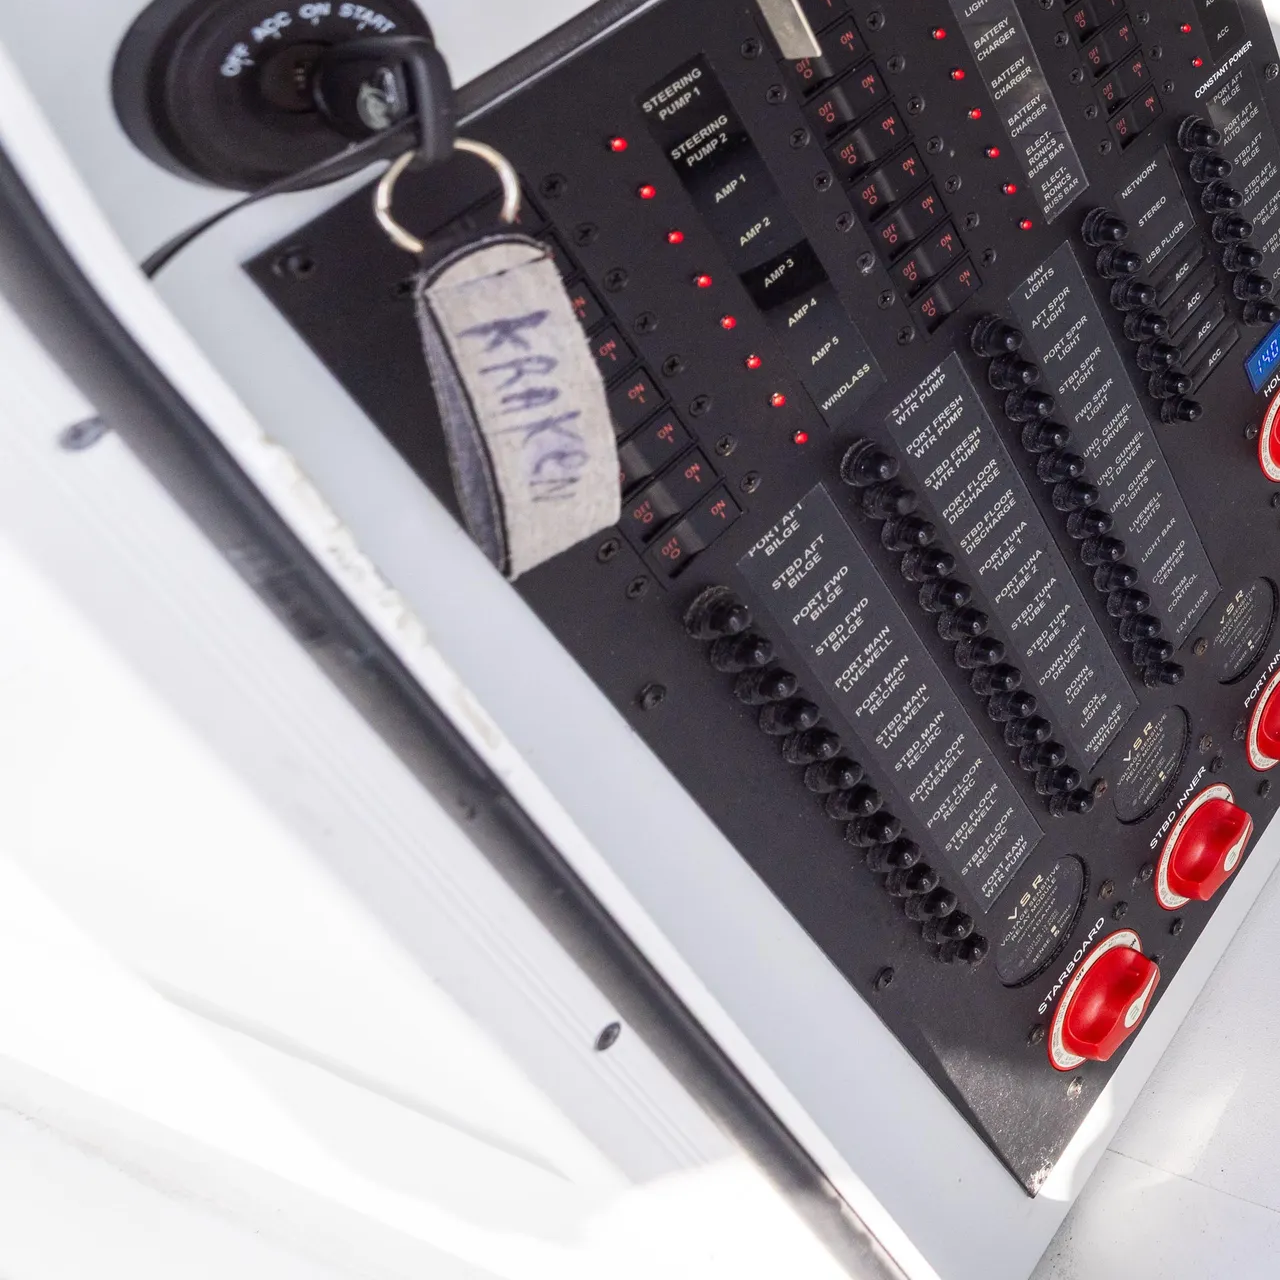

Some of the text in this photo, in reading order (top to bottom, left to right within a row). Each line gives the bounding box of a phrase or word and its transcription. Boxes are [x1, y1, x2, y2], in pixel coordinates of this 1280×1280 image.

[220, 1, 396, 77] OFF ACC ON START
[973, 17, 1009, 49] BATTERY
[977, 27, 1016, 61] CHARGER
[1217, 26, 1229, 40] ACC
[1194, 40, 1253, 99] CONSTANT POWER
[1213, 70, 1244, 104] PORT AFT
[642, 67, 702, 113] STEERING
[658, 86, 701, 121] PUMP 1
[818, 75, 875, 117] OFF ON
[1221, 84, 1241, 106] BILGE
[1007, 94, 1042, 126] BATTERY
[1011, 103, 1048, 138] CHARGER
[671, 114, 728, 160] STEERING
[686, 132, 728, 167] PUMP 2
[1028, 137, 1057, 166] RONICS
[1234, 132, 1262, 165] STBD AFT
[1028, 143, 1065, 179] BUSS BAR
[1242, 146, 1261, 167] BILGE
[714, 173, 746, 203] AMP 1
[1043, 178, 1079, 214] BUSS BAR
[1044, 173, 1071, 201] RONICS
[1121, 160, 1157, 199] NETWORK
[1138, 196, 1167, 227] STEREO
[1252, 205, 1269, 225] PORT
[1261, 204, 1279, 225] BILGE
[739, 217, 771, 246] AMP 2
[1145, 221, 1184, 264] USB PLUGS
[763, 258, 794, 288] AMP 3
[1024, 267, 1055, 300] LIGHTS
[1027, 265, 1044, 284] NAV
[1175, 263, 1189, 282] ACC
[788, 297, 817, 327] AMP 4
[1031, 286, 1071, 329] AFT SPDR
[1042, 302, 1066, 329] LIGHT
[811, 336, 839, 365] AMP 5
[821, 363, 870, 411] WINDLASS
[942, 458, 998, 518] PORT FLOOR
[948, 468, 1001, 525] DISCHARGE
[1141, 517, 1176, 563] LIGHT BAR
[771, 534, 825, 590] STBD AFT
[787, 552, 822, 589] BILGE
[1152, 540, 1186, 584] COMMAND
[1158, 550, 1185, 585] CENTER
[792, 565, 849, 625] PORT FWD
[809, 585, 843, 621] BILGE
[1167, 573, 1198, 613] CONTROL
[1171, 576, 1187, 597] TRIM
[815, 597, 869, 656] STBD FWD
[1176, 589, 1209, 634] 12V PLUGS
[831, 616, 864, 652] BILGE
[834, 625, 891, 688] PORT MAIN
[842, 639, 893, 692] LIVEWELL
[1065, 664, 1089, 697] DOWN
[1066, 669, 1094, 705] LIGHTS
[1244, 674, 1267, 708] PORT
[1080, 693, 1107, 729] LIGHTS
[1082, 693, 1099, 716] BOX
[1084, 702, 1122, 753] WINDLASS
[1093, 715, 1121, 753] SWITCH
[1150, 812, 1176, 850] STBD
[1177, 765, 1207, 810] INNER
[981, 835, 1025, 893] PORT RAW
[985, 841, 1028, 899] WTR PUMP
[1037, 917, 1105, 1016] STARBOARD
